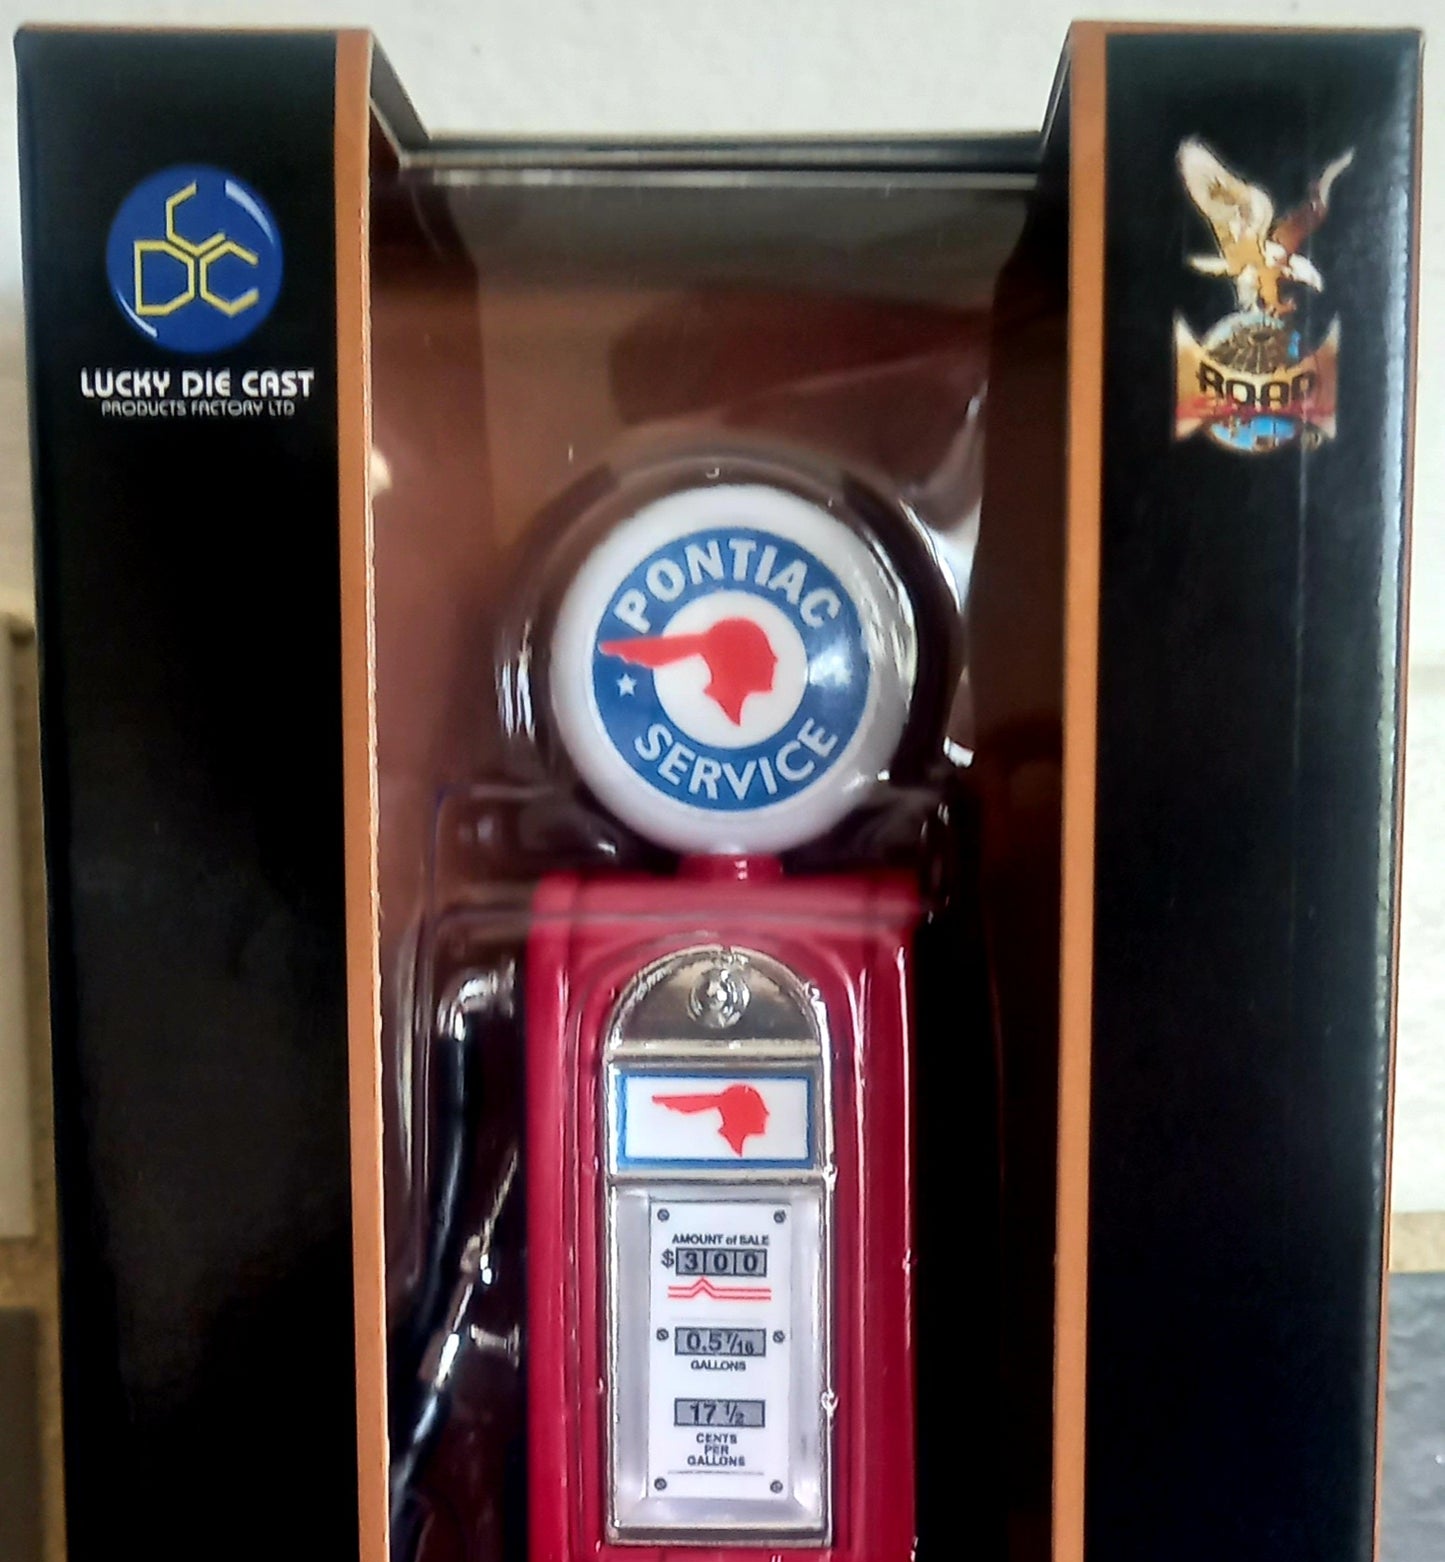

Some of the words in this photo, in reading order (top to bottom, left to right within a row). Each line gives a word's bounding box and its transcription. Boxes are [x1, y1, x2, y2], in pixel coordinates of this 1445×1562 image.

[80, 367, 171, 398] LUCKY
[182, 368, 232, 398] DIE
[242, 367, 315, 398] CAST
[102, 400, 186, 417] PRODUCTS
[191, 400, 264, 417] FACTORY
[269, 401, 296, 417] LTD
[613, 537, 842, 634] PONTIAC
[634, 717, 838, 801] SERVICE
[672, 1234, 724, 1245] AMOUNT
[726, 1234, 738, 1245] of
[739, 1235, 769, 1246] SALE
[691, 1360, 746, 1371] GALLONS
[696, 1433, 737, 1444] CENTS
[704, 1445, 729, 1455] PER
[687, 1456, 745, 1467] GALLONS
